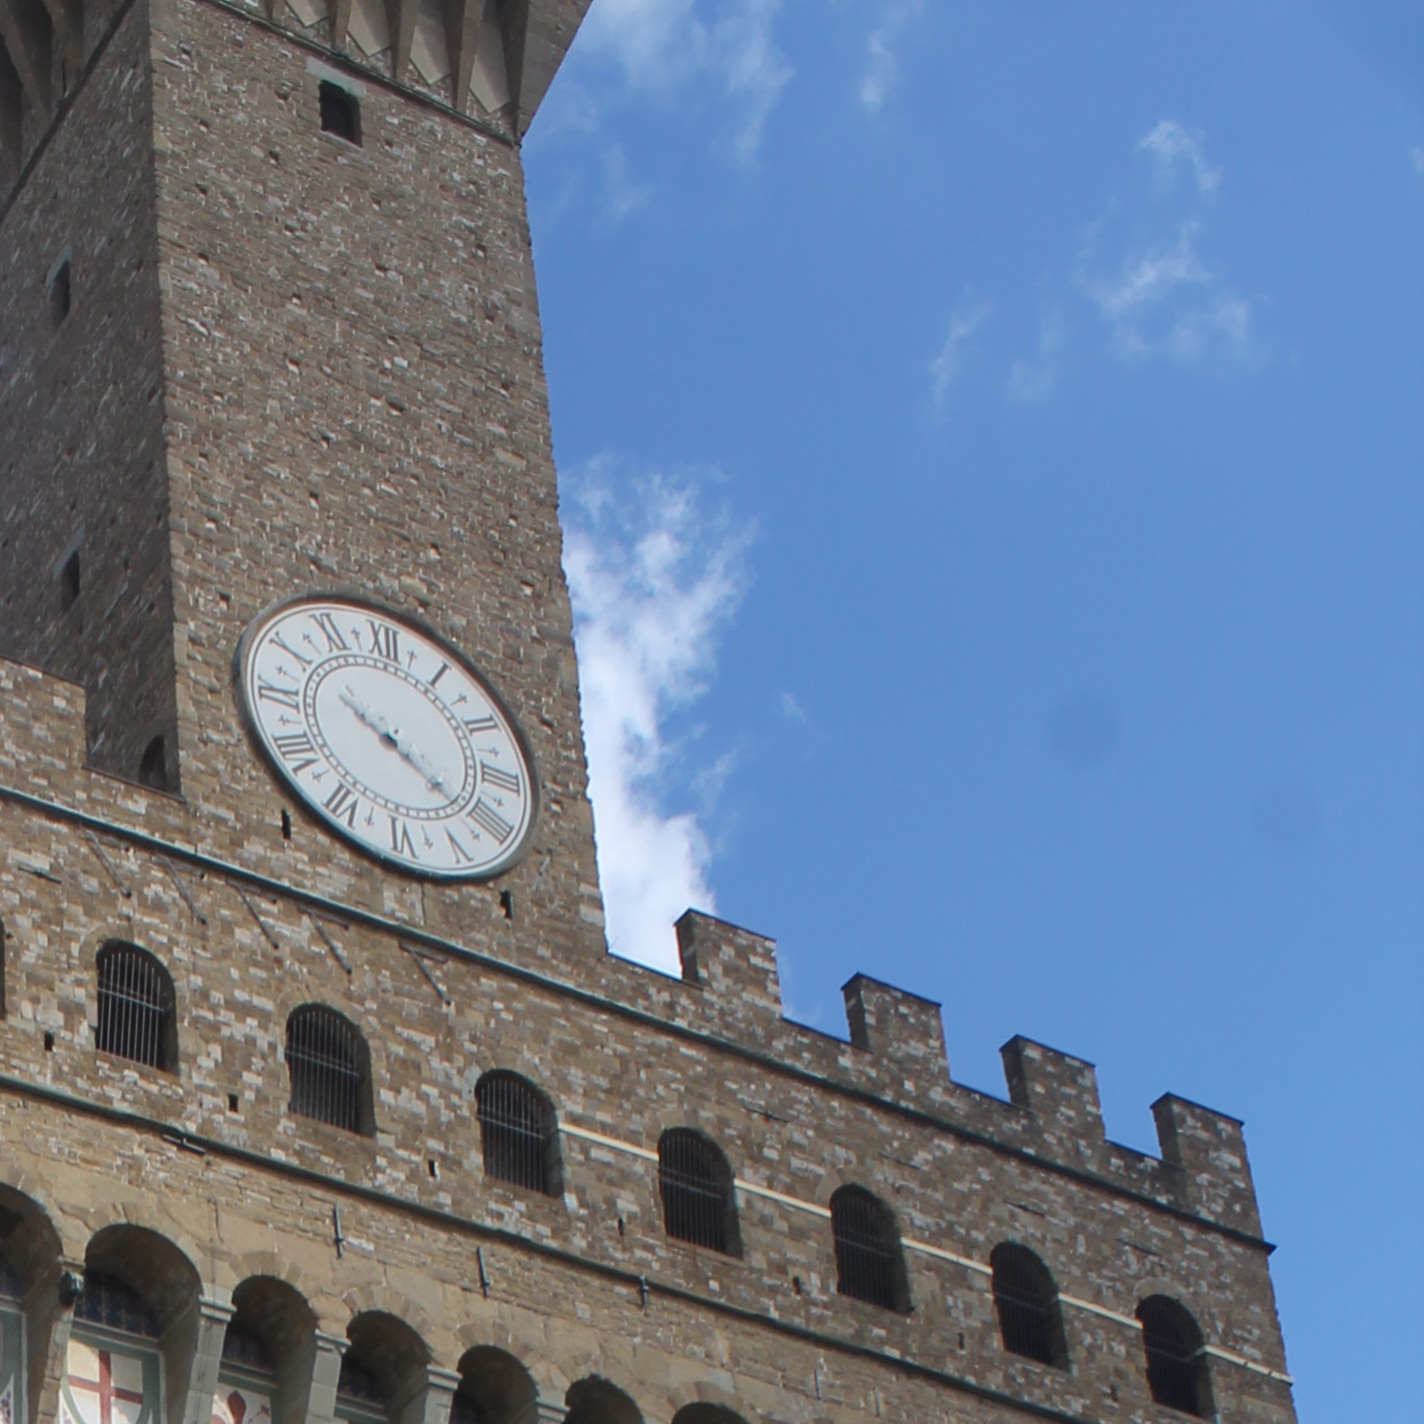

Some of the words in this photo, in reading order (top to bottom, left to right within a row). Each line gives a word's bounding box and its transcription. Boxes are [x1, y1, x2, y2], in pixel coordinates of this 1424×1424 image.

[268, 630, 313, 673] X
[365, 618, 403, 666] XII
[427, 660, 452, 689] I
[462, 713, 502, 737] II
[480, 760, 521, 797] III
